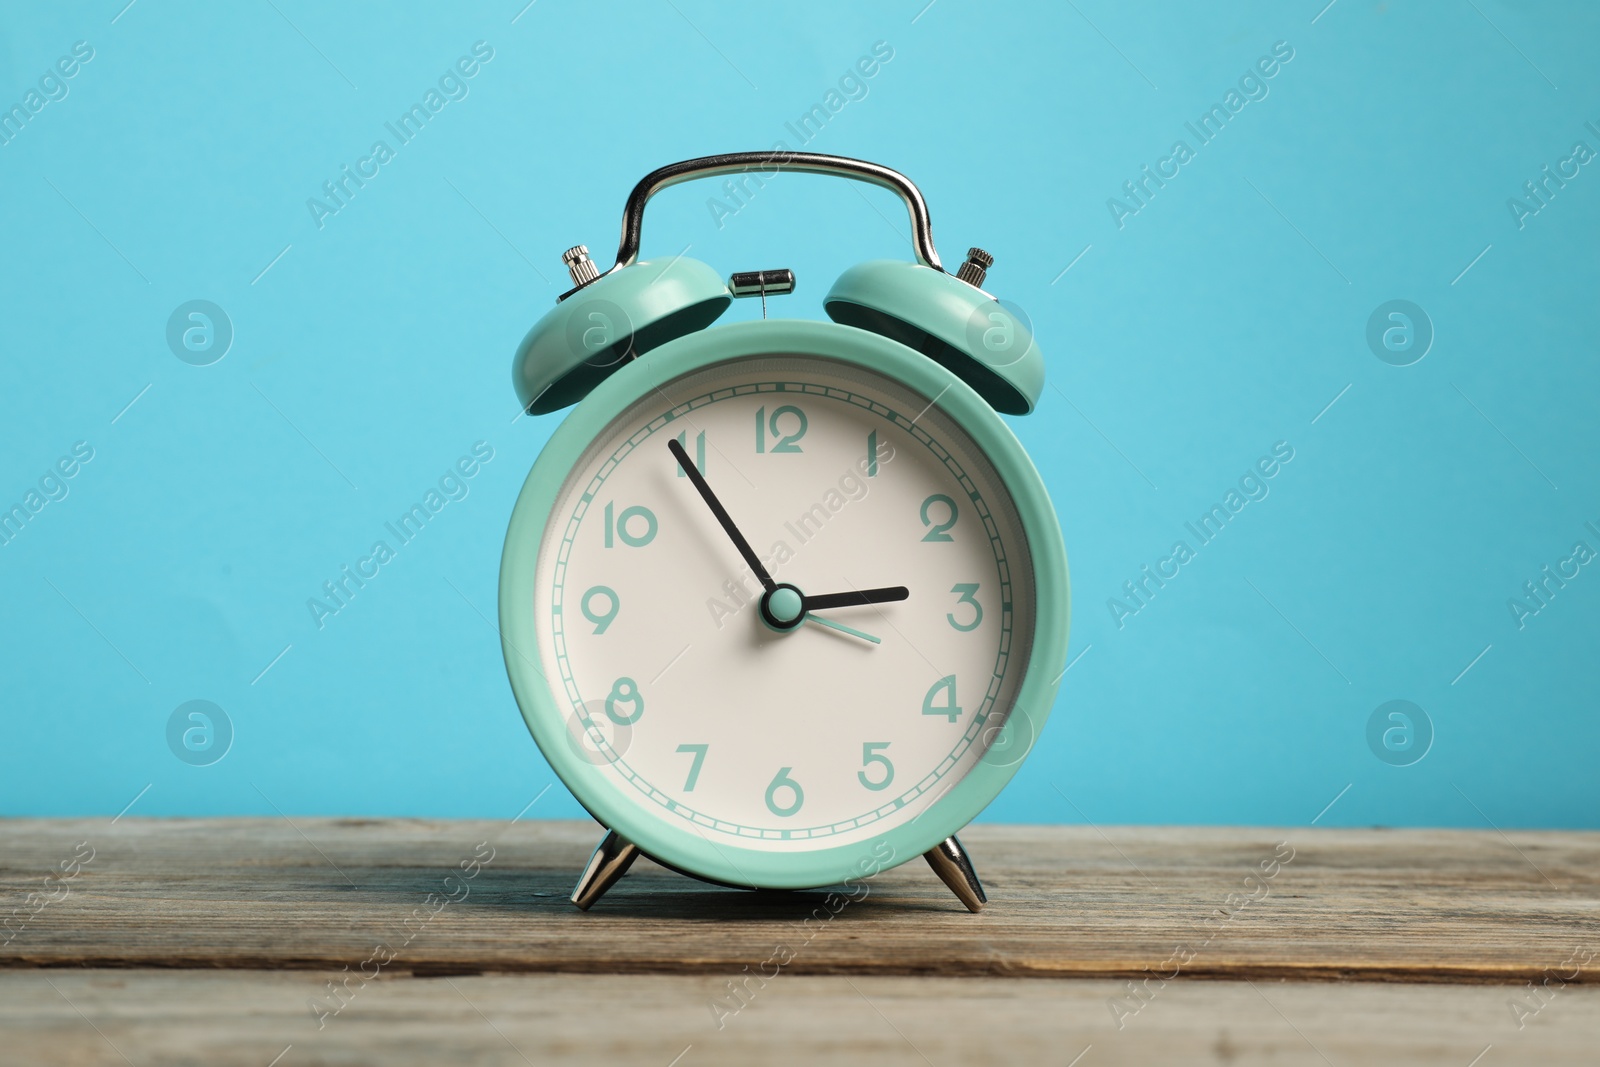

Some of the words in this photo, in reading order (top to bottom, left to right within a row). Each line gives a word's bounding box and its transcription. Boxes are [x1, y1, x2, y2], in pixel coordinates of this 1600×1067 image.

[677, 429, 706, 477] 11
[755, 405, 808, 453] 12
[868, 428, 877, 477] 1
[604, 500, 658, 548] 10
[919, 494, 959, 542] 2
[580, 585, 620, 635] 9
[946, 583, 983, 632] 3
[604, 677, 644, 726] 8
[921, 674, 962, 723] 4
[675, 744, 709, 792] 7
[857, 742, 895, 791] 5
[764, 767, 804, 817] 6
